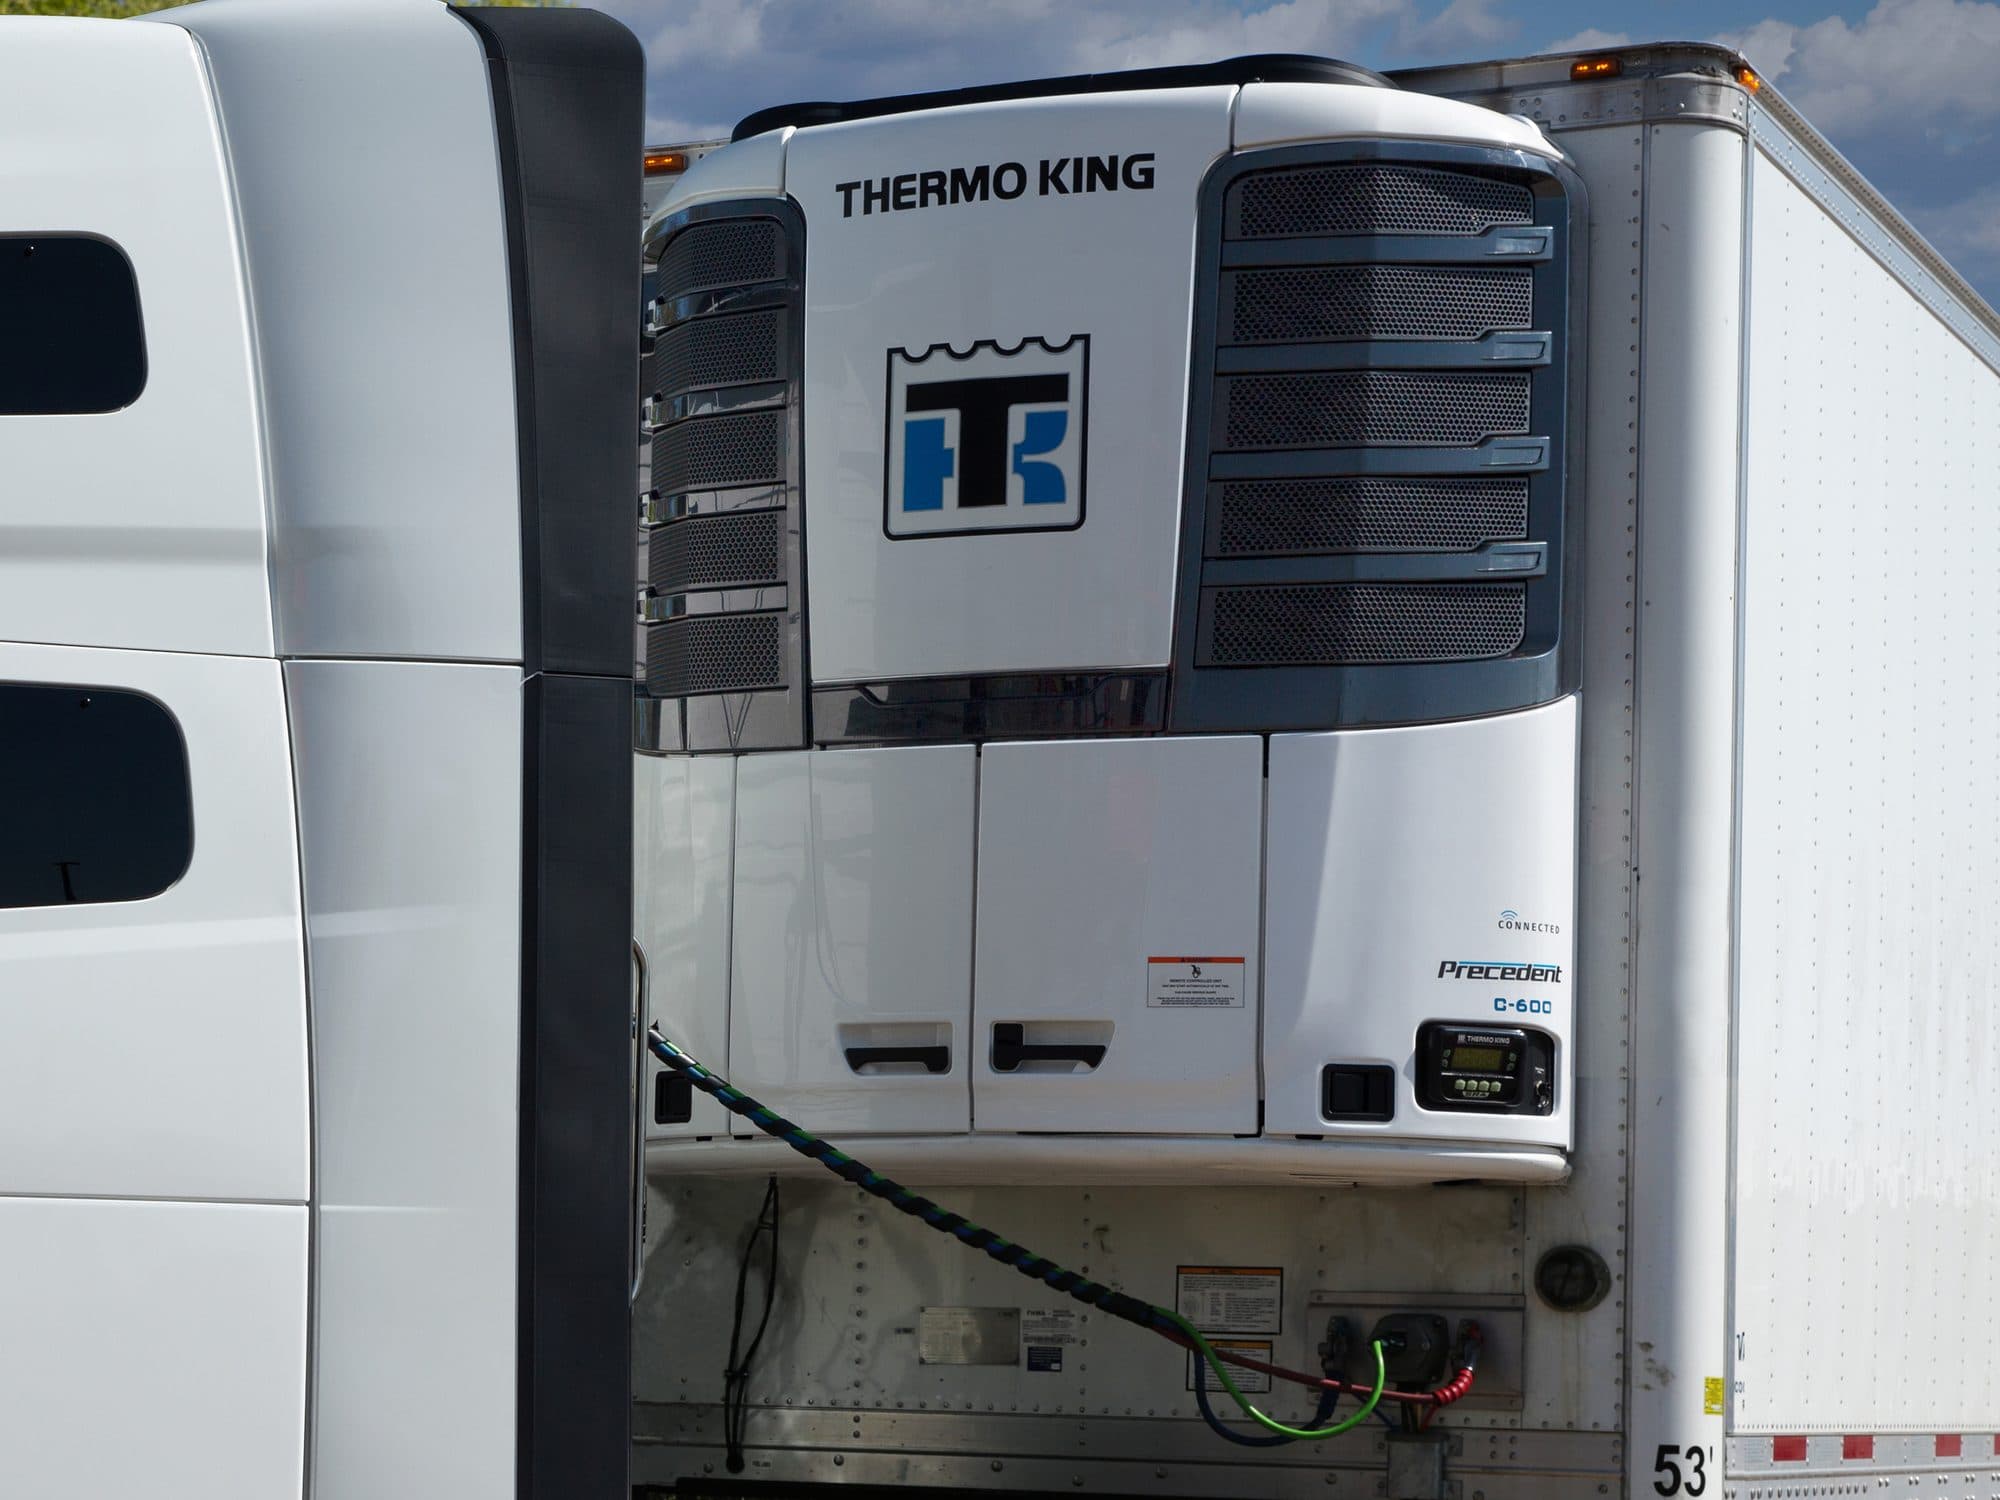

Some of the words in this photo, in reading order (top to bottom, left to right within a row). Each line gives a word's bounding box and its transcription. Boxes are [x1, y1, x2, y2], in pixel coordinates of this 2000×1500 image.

[835, 162, 1027, 218] THERMO
[1039, 152, 1156, 196] KING
[1498, 920, 1560, 934] CONNECTED
[1437, 961, 1562, 983] Precedent
[1494, 997, 1551, 1014] C-600
[1467, 1035, 1494, 1043] THERMO
[1494, 1036, 1510, 1044] KING
[1653, 1444, 1713, 1497] 53'
